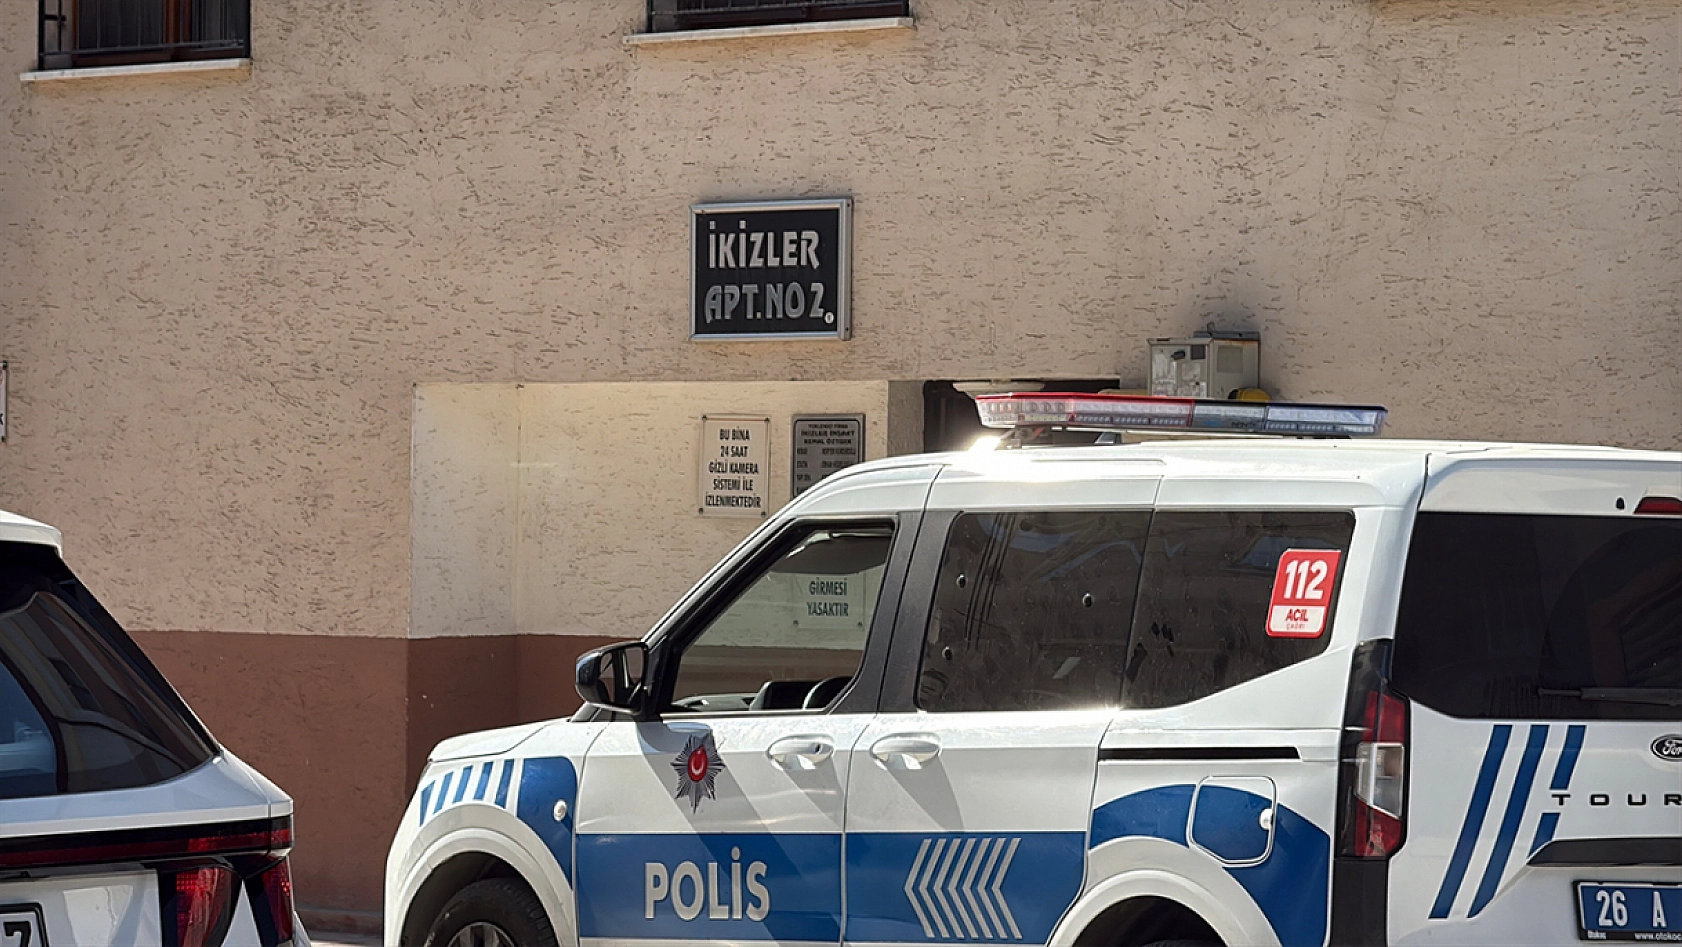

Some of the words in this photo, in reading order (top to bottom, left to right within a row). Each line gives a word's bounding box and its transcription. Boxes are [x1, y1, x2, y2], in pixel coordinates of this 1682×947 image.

[709, 220, 820, 270] İKİZLER
[719, 428, 730, 441] BU
[731, 425, 750, 441] BİNA
[720, 446, 729, 457] 24
[730, 446, 748, 458] SAAT
[709, 460, 727, 474] GİZLİ
[729, 462, 759, 475] KAMERA
[713, 476, 741, 491] SİSTEMİ
[742, 476, 754, 491] İLE
[705, 492, 762, 508] İZLENMEKTEDİR
[809, 577, 848, 596] GİRMESİ
[1284, 560, 1328, 599] 112
[806, 601, 849, 617] YASAKTIR
[644, 845, 771, 922] POLİS
[1595, 889, 1628, 928] 26
[1652, 890, 1667, 928] A
